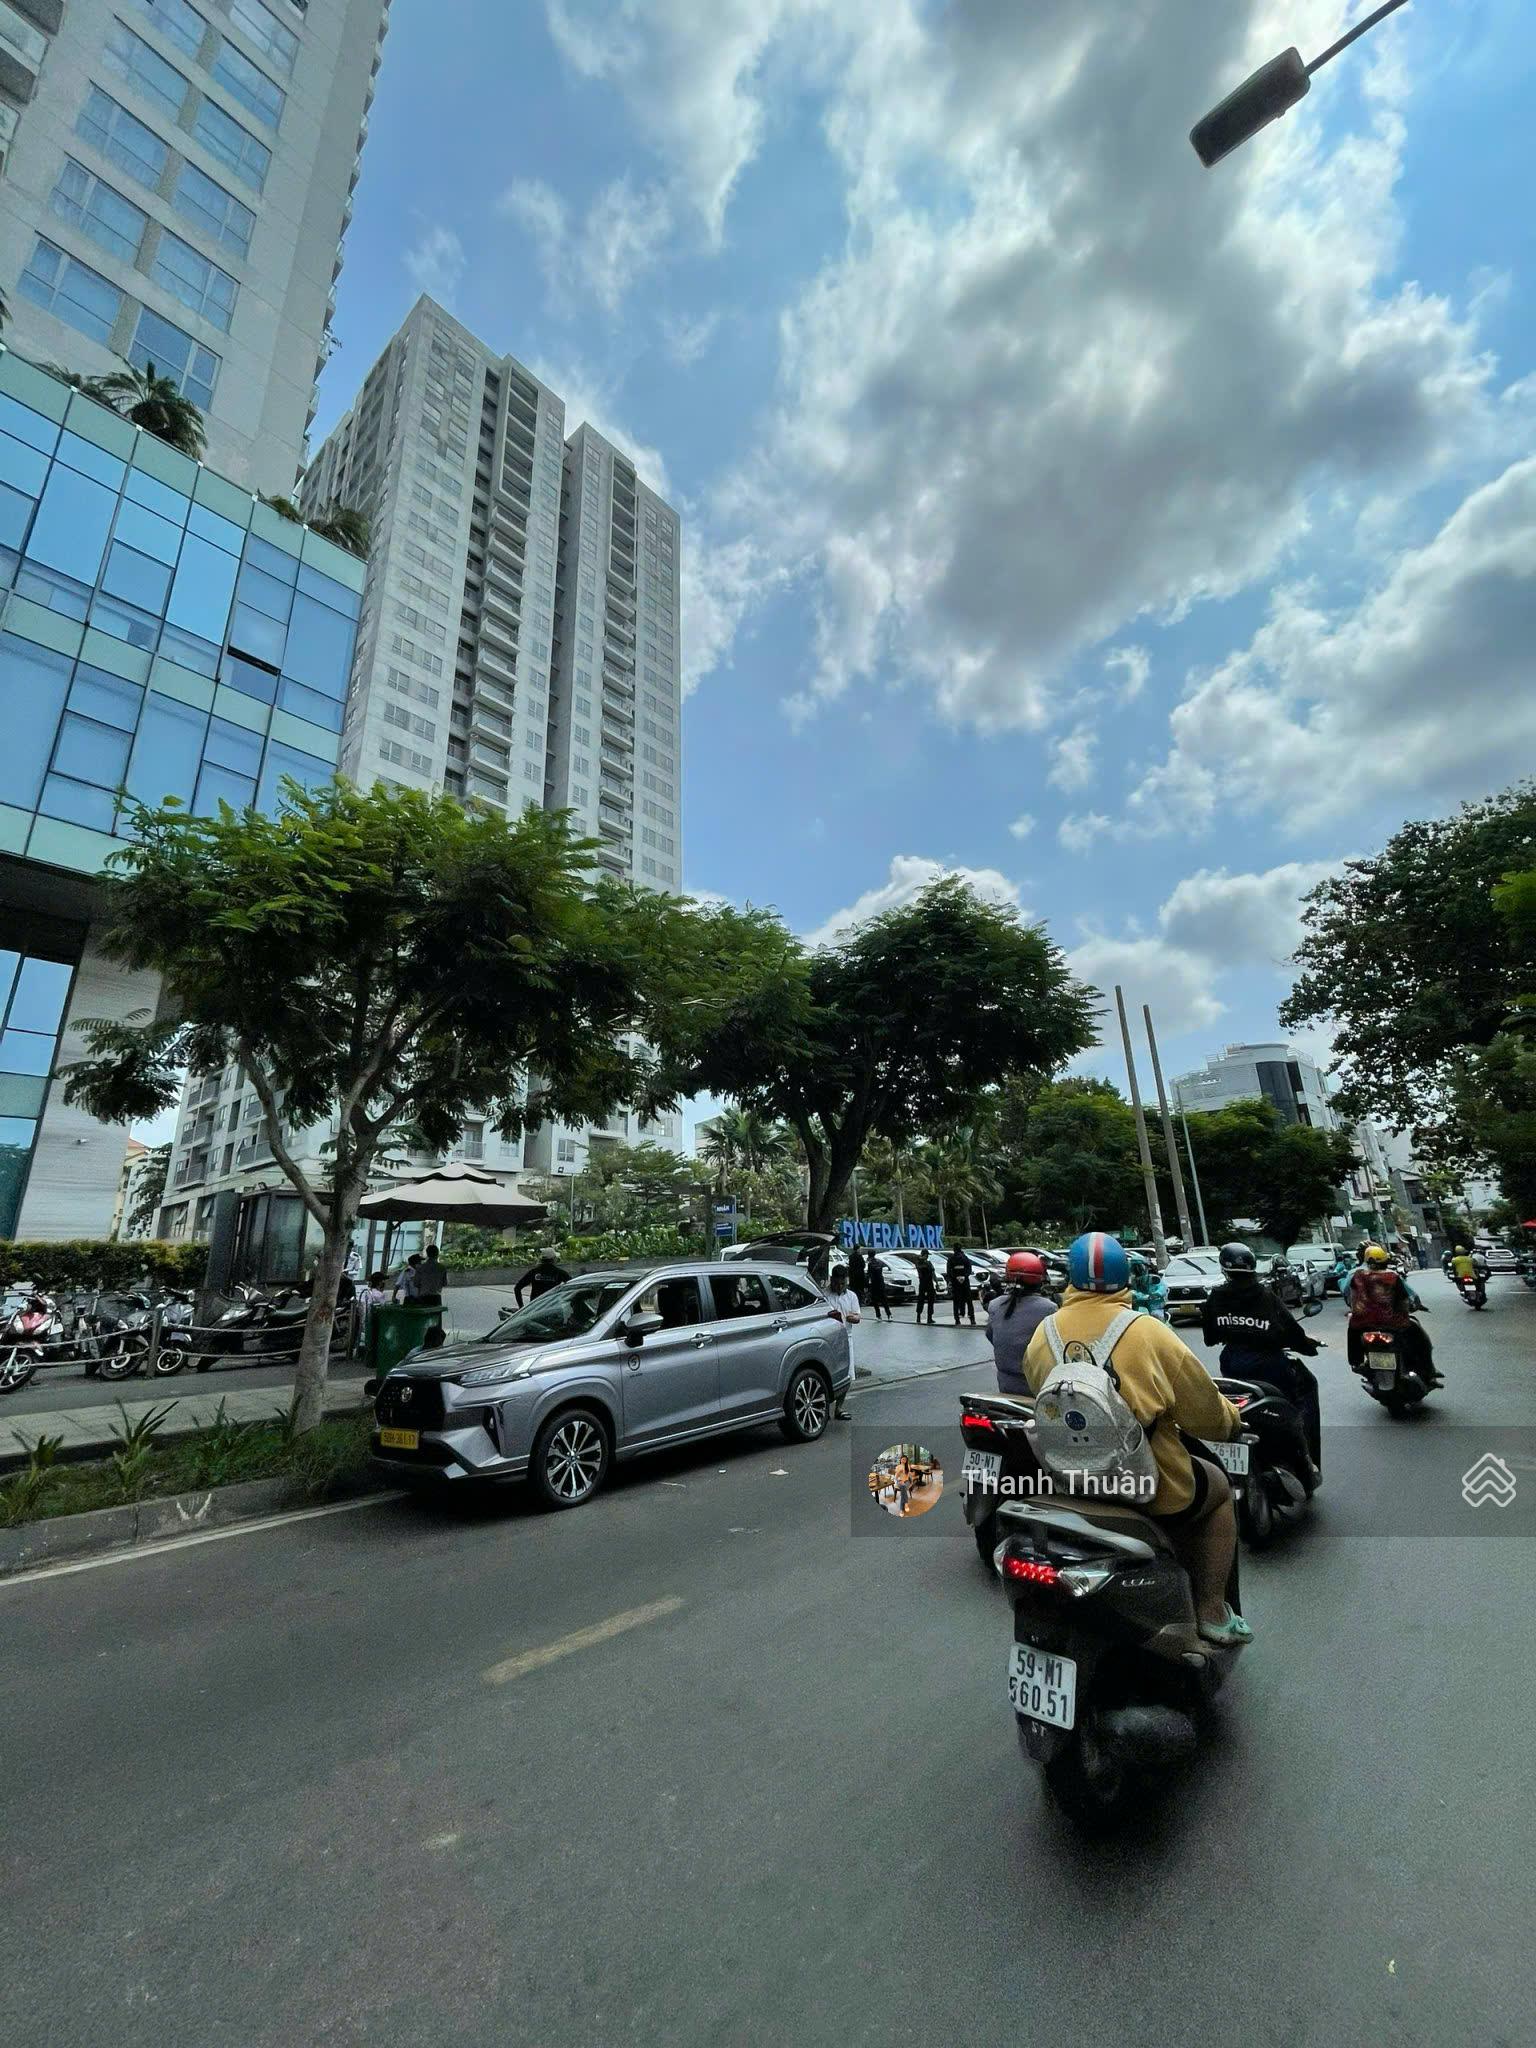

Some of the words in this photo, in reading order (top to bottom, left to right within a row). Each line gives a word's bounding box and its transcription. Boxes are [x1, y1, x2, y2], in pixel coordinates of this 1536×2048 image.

[843, 1221, 905, 1248] RIVERA
[908, 1224, 944, 1249] PARK
[1217, 1313, 1271, 1330] missout
